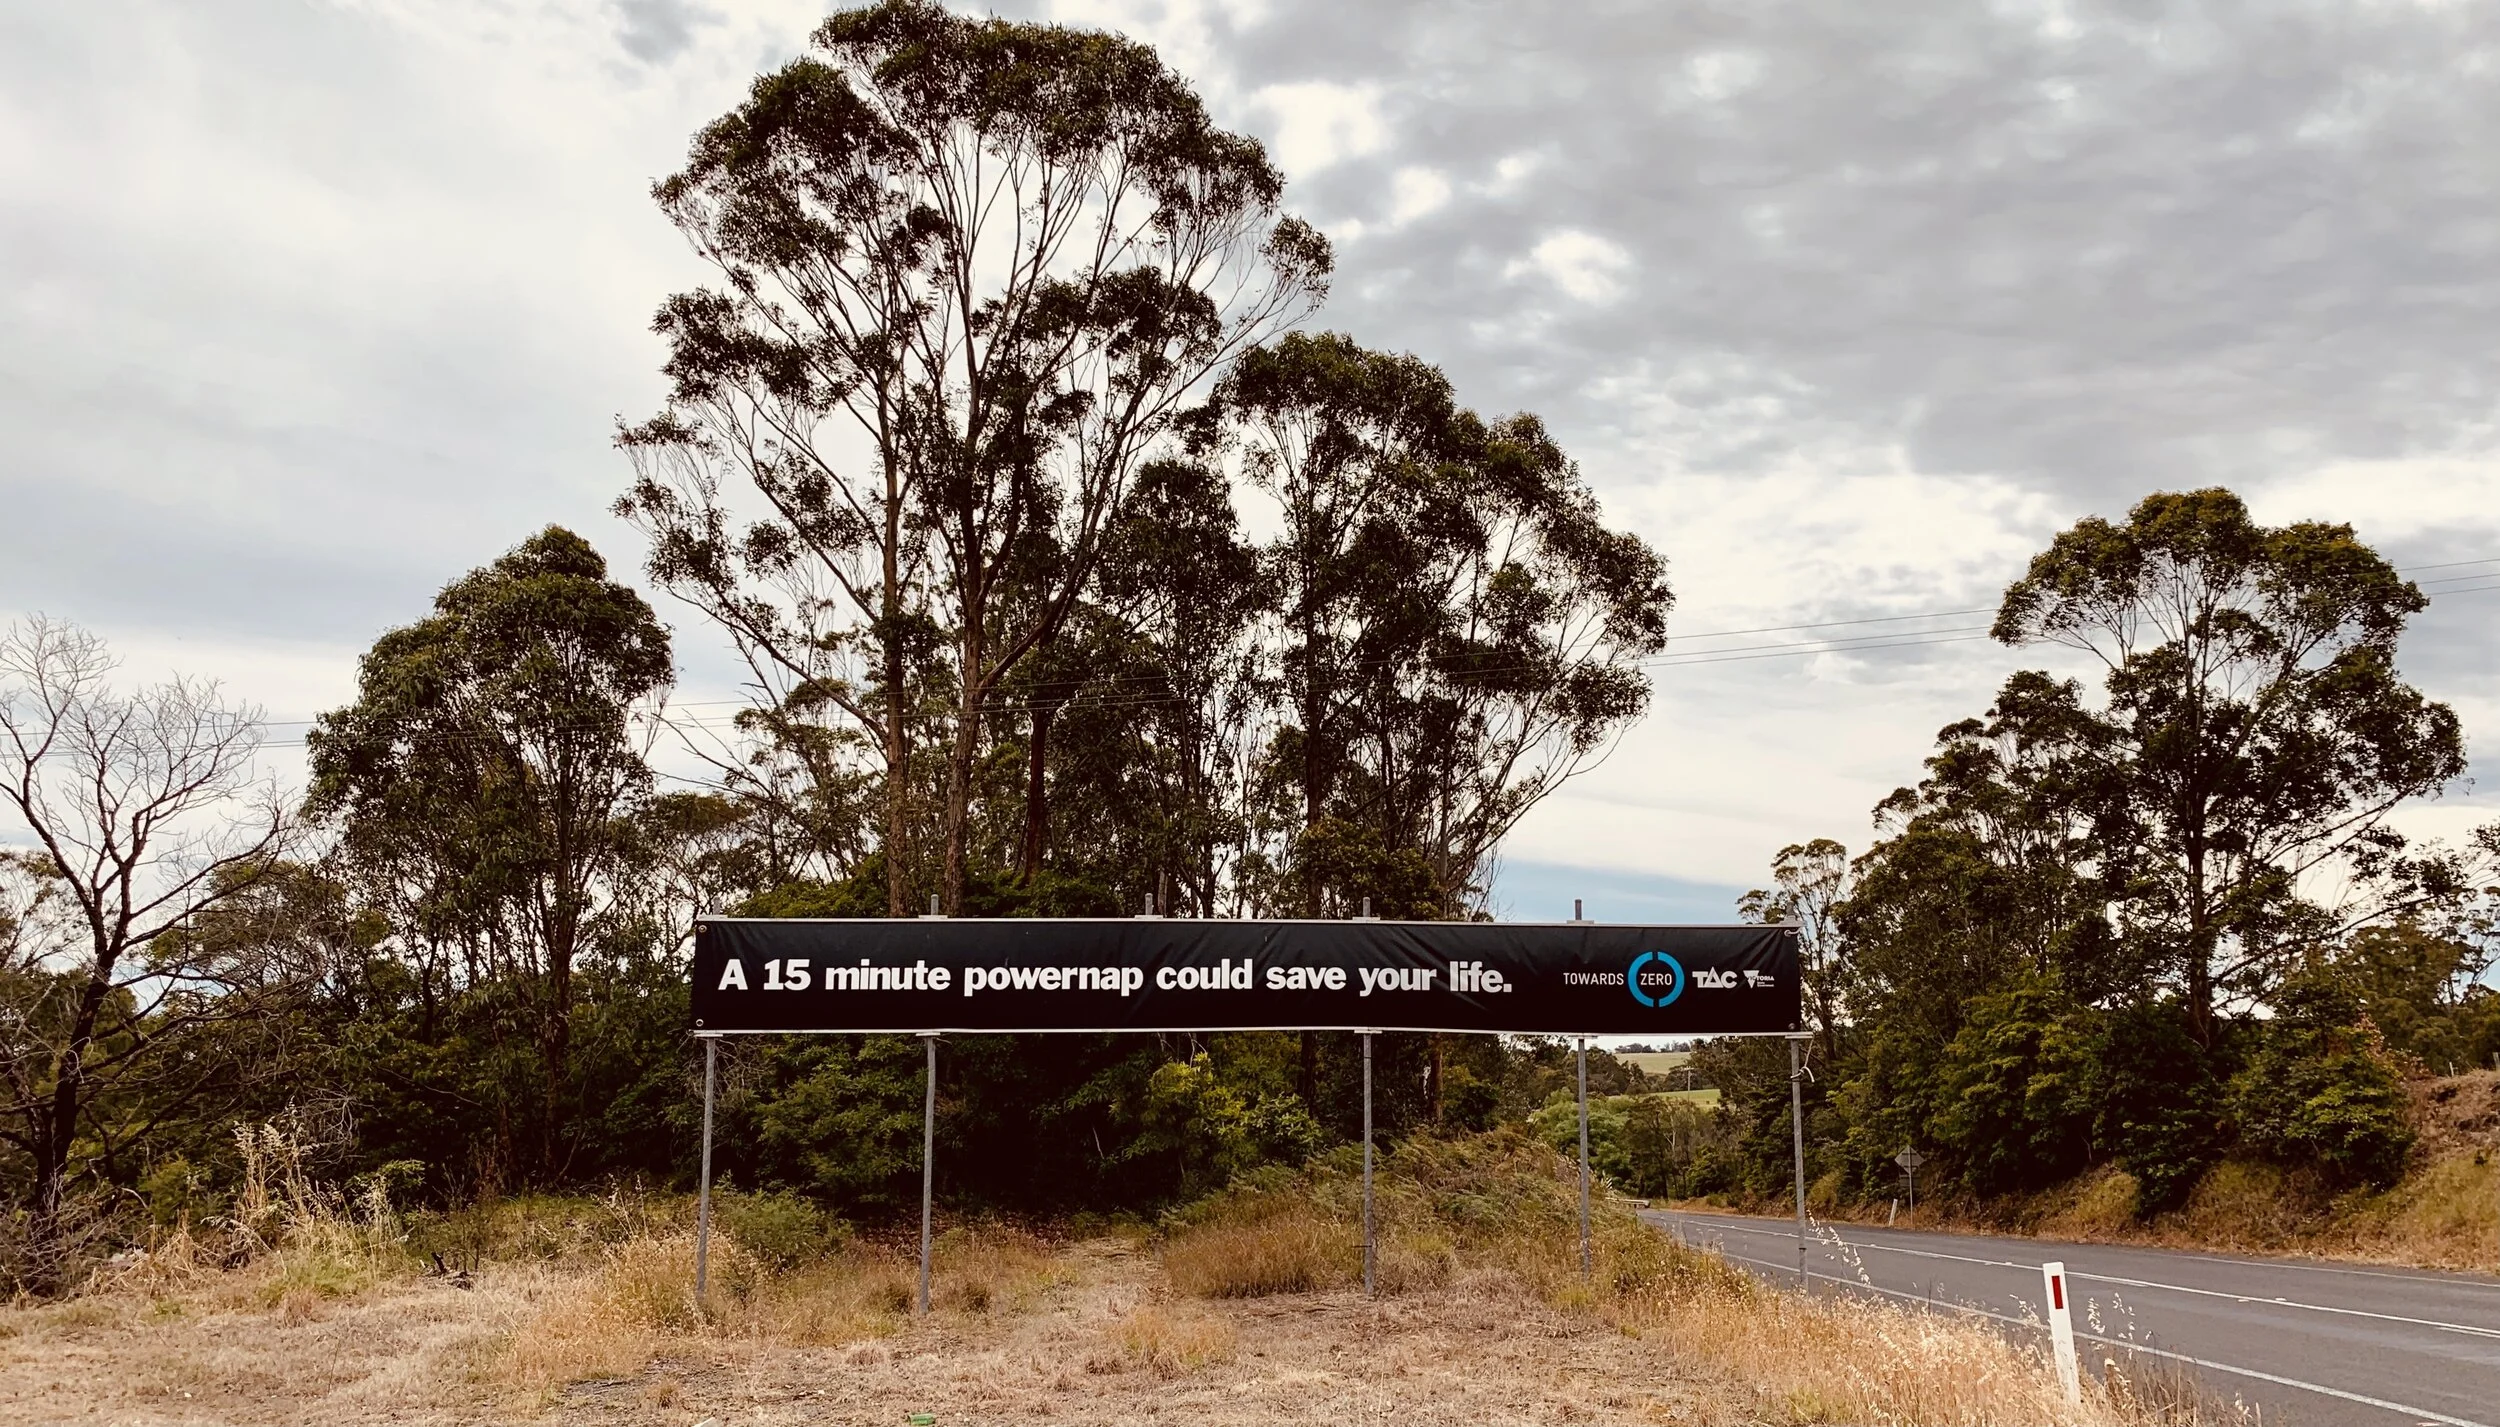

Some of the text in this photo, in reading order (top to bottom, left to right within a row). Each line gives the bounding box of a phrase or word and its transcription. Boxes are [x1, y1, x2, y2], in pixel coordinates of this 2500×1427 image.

[718, 959, 1513, 997] A 15 minute powernap could save your life.
[1563, 972, 1673, 986] TOWARDS ZERO
[1692, 966, 1738, 989] TAC
